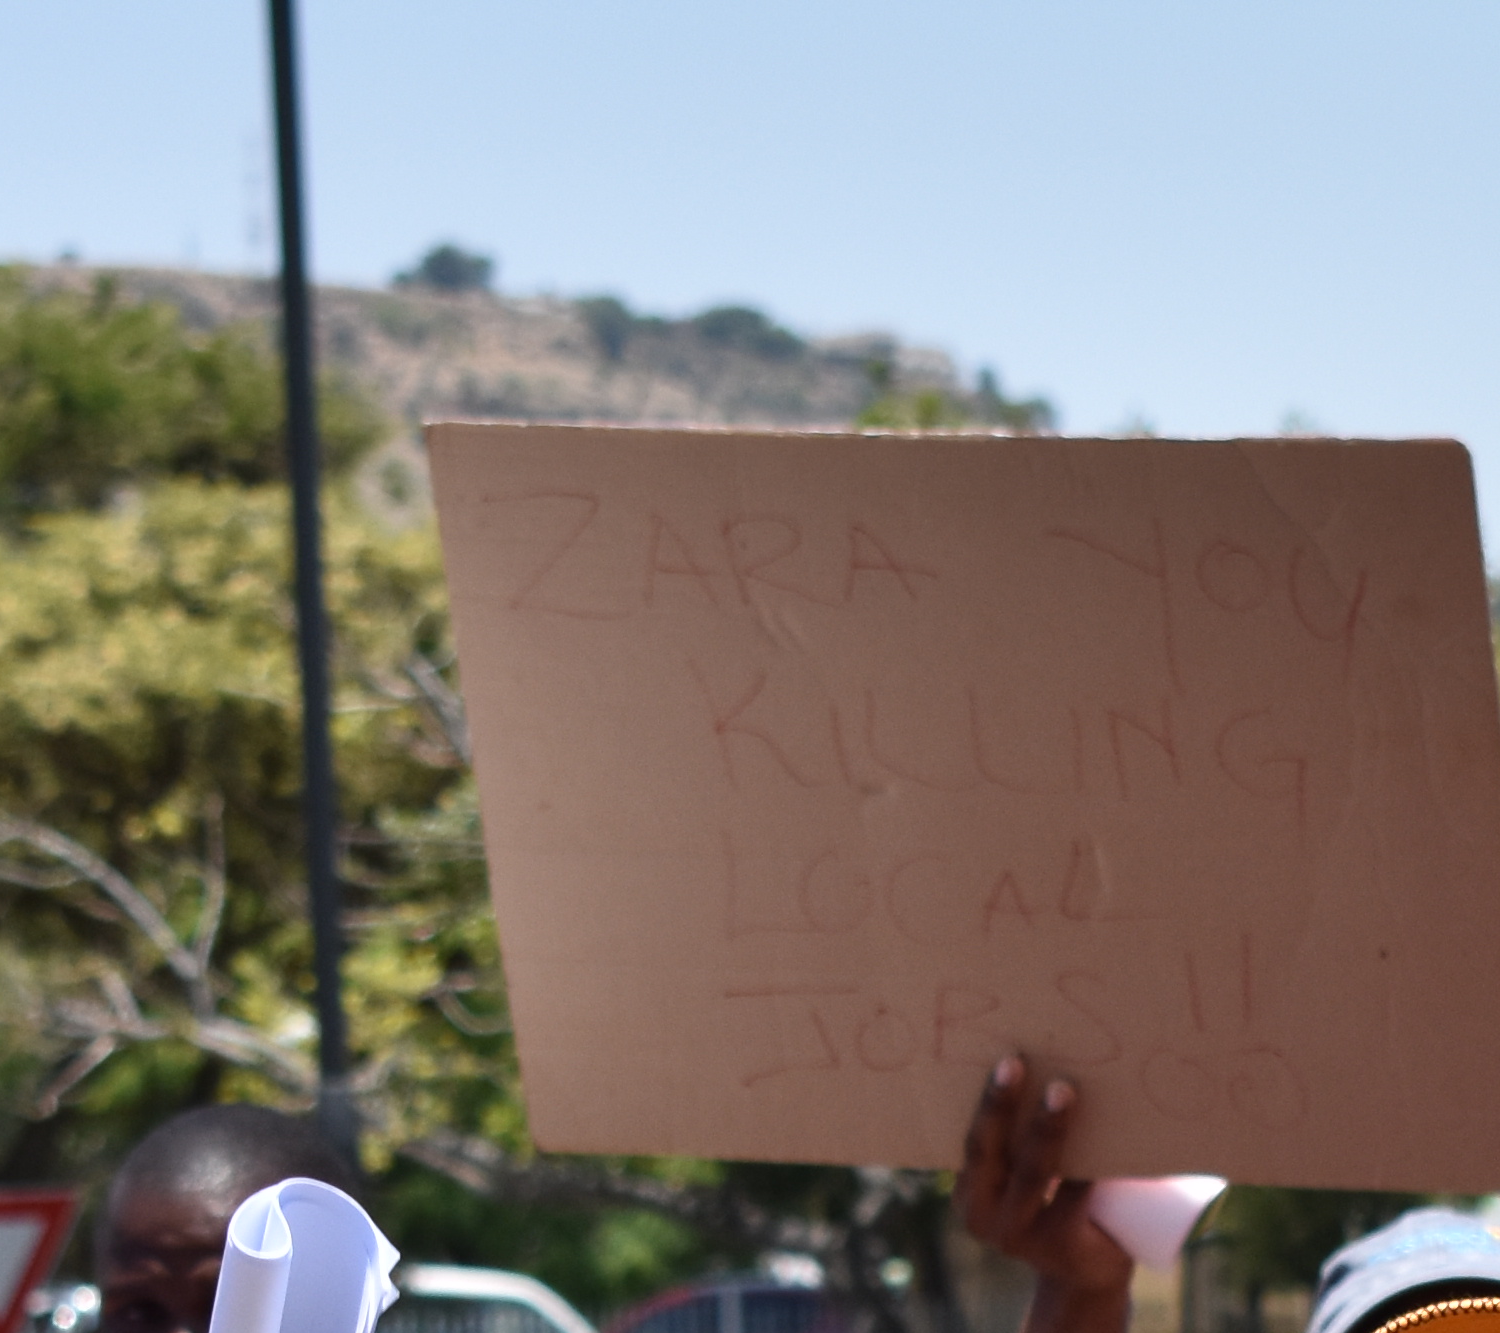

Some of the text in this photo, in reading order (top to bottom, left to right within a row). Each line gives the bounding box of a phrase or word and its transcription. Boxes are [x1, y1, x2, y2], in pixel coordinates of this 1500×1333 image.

[478, 490, 1368, 692] ZARA YOU
[686, 657, 1308, 832] KILLING
[718, 824, 1174, 946] LOCAL
